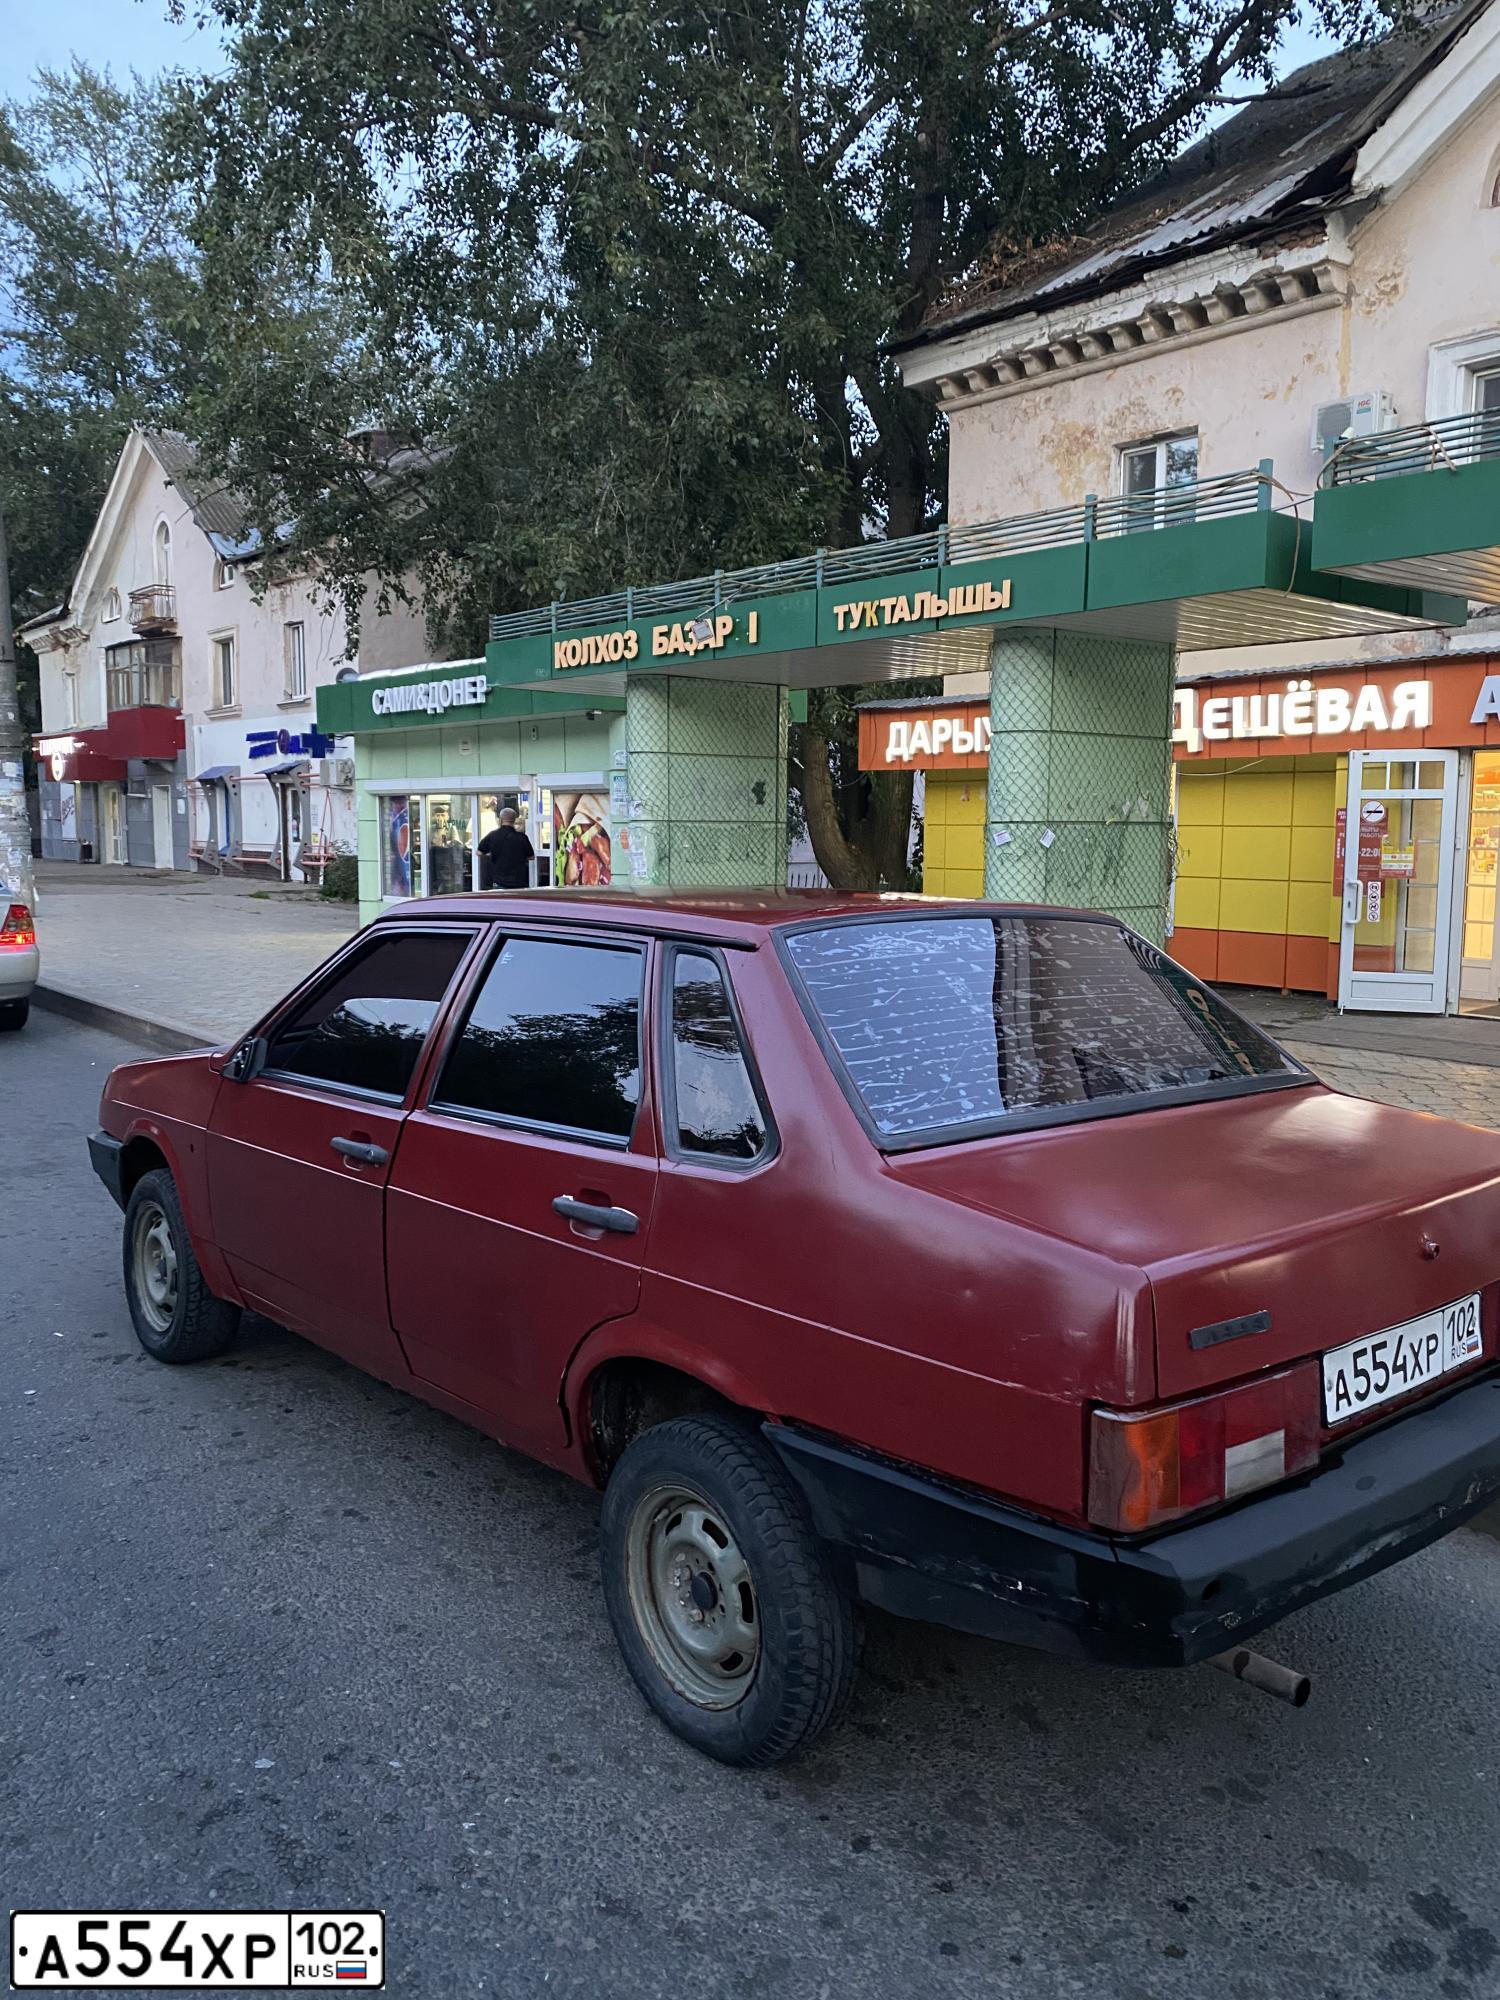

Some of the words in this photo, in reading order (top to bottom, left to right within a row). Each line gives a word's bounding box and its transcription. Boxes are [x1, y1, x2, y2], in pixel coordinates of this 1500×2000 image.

[833, 579, 1011, 631] ТУКТАЛЫШЫ
[554, 629, 638, 669] КОЛХОЗ
[372, 675, 486, 714] САМИ&ДОНЕР
[1335, 1333, 1438, 1412] А554ХР
[1447, 1301, 1475, 1346] 102
[1451, 1342, 1467, 1361] RUS
